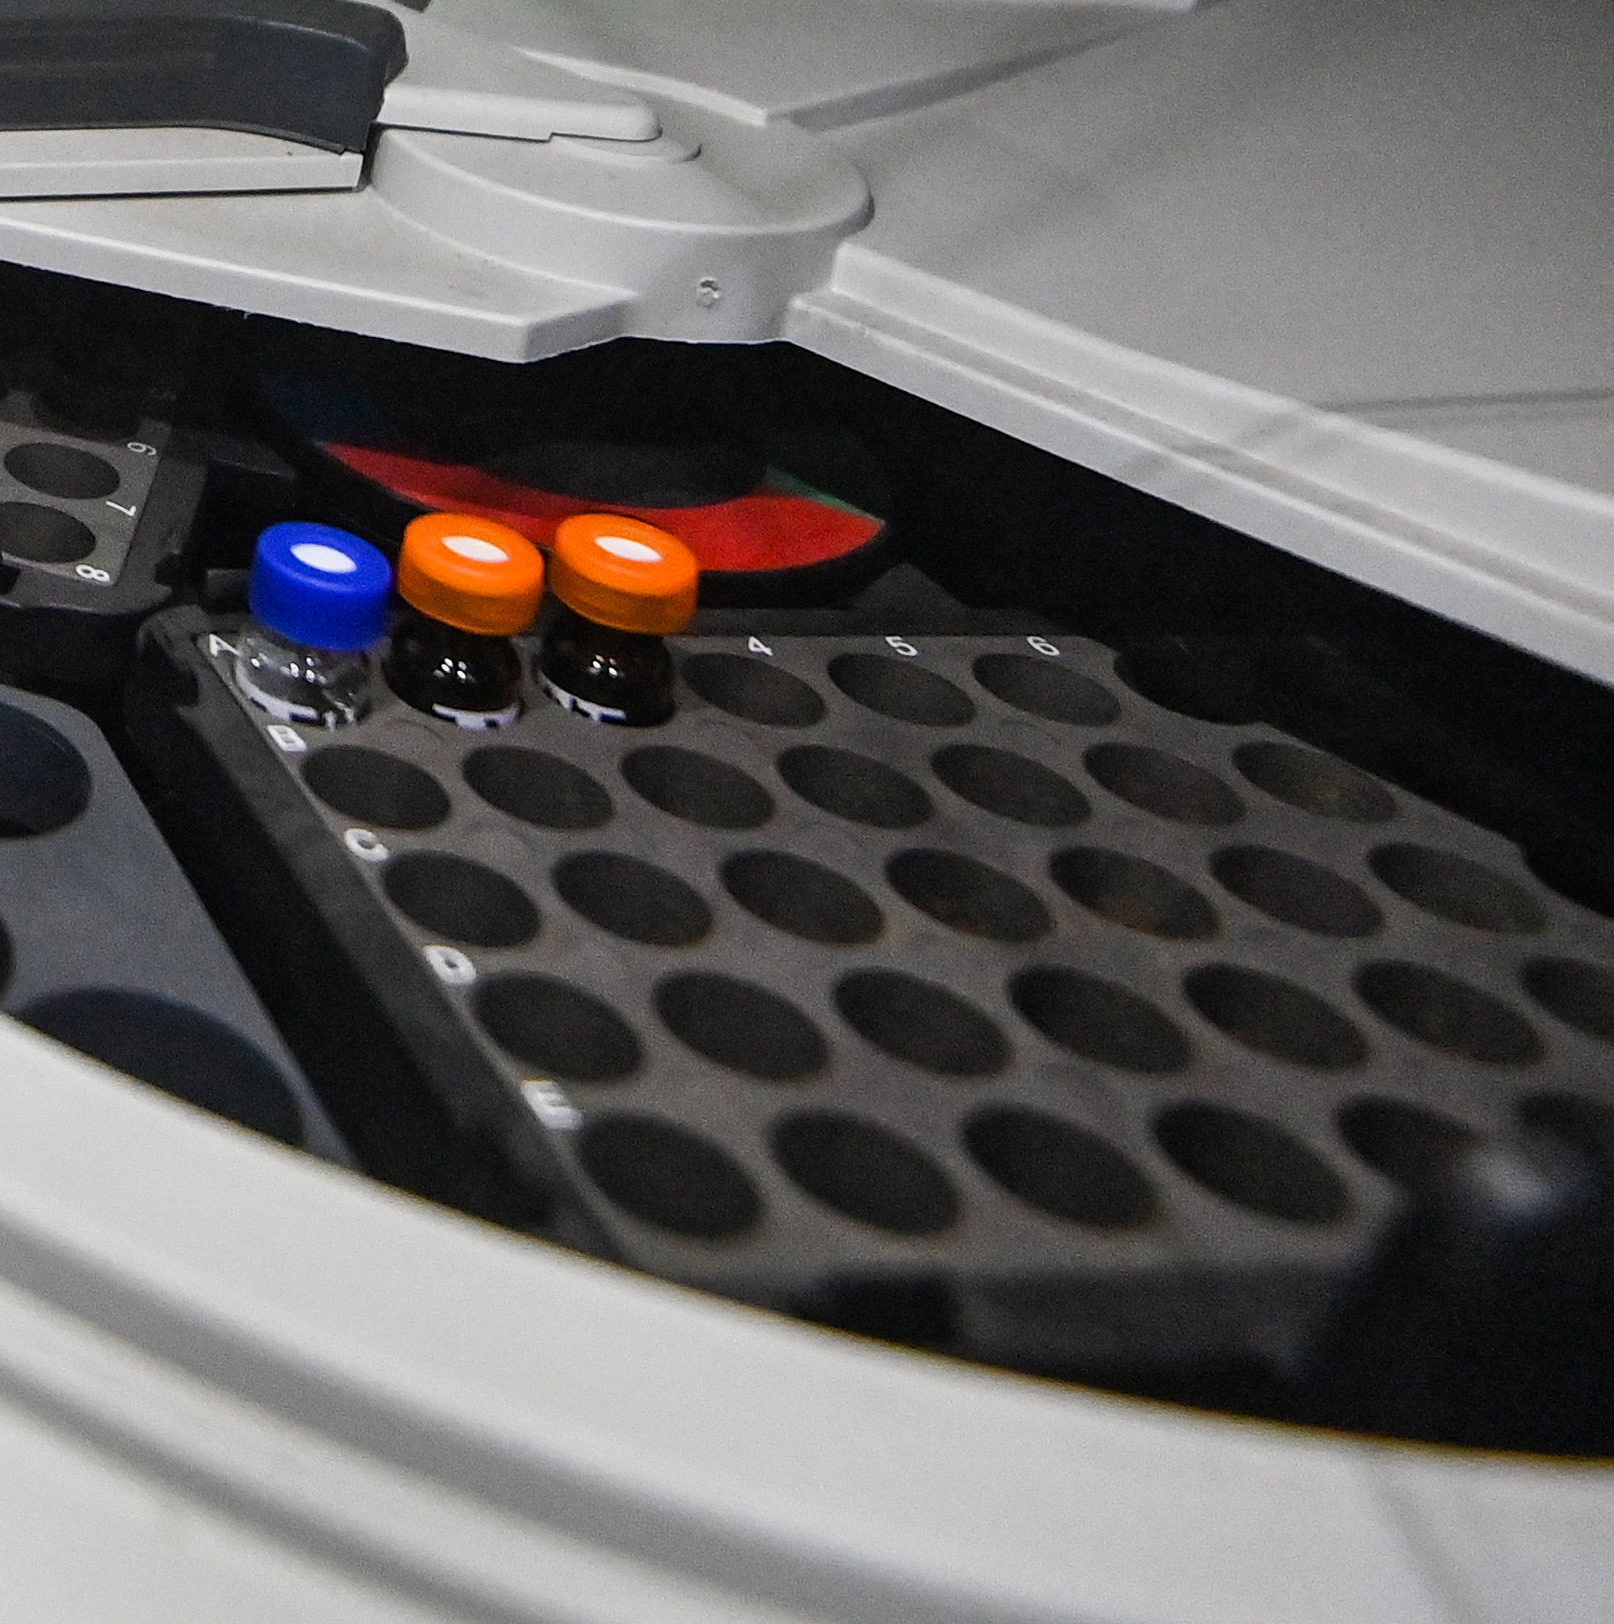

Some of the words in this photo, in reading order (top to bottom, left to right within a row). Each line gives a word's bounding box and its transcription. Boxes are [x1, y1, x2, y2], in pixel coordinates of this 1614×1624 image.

[127, 441, 157, 456] 6
[105, 499, 137, 517] 7
[75, 564, 111, 582] 8
[209, 632, 240, 657] A
[747, 636, 773, 656] 4
[884, 636, 918, 657] 5
[1026, 636, 1061, 657] 6
[267, 725, 307, 752] B
[344, 829, 389, 862] C
[423, 945, 476, 985] D
[520, 1079, 584, 1130] E
